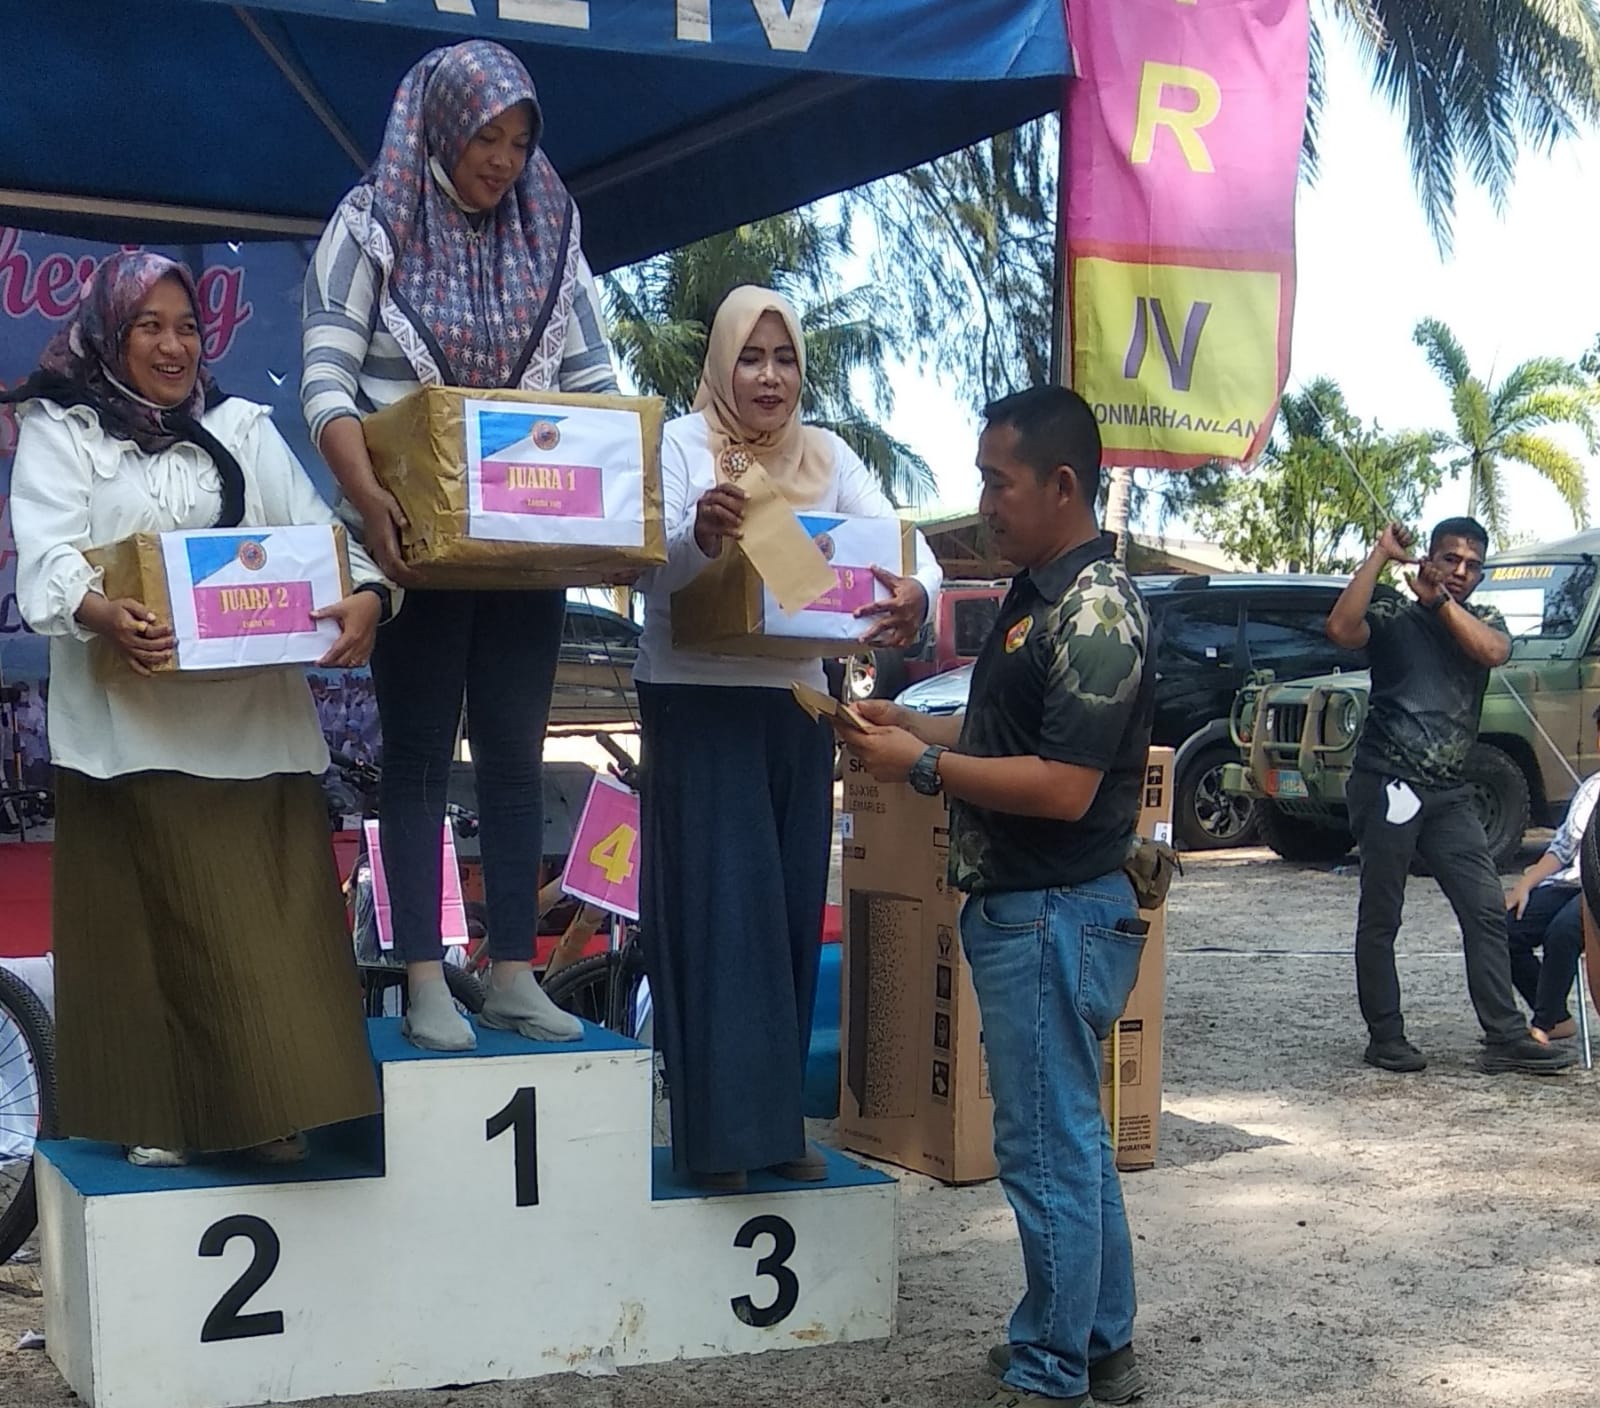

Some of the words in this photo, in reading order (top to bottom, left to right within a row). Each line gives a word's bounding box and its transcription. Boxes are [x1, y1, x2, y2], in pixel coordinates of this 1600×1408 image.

[1131, 61, 1221, 173] R
[1090, 402, 1262, 438] ONMARHANLAN
[508, 466, 562, 491] JUARA
[567, 469, 576, 491] 1
[220, 587, 273, 614] JUARA
[277, 587, 289, 608] 2
[845, 569, 854, 590] 3
[590, 823, 638, 885] 4
[486, 1086, 540, 1208] 1
[198, 1214, 284, 1344] 2
[730, 1214, 799, 1328] 3
